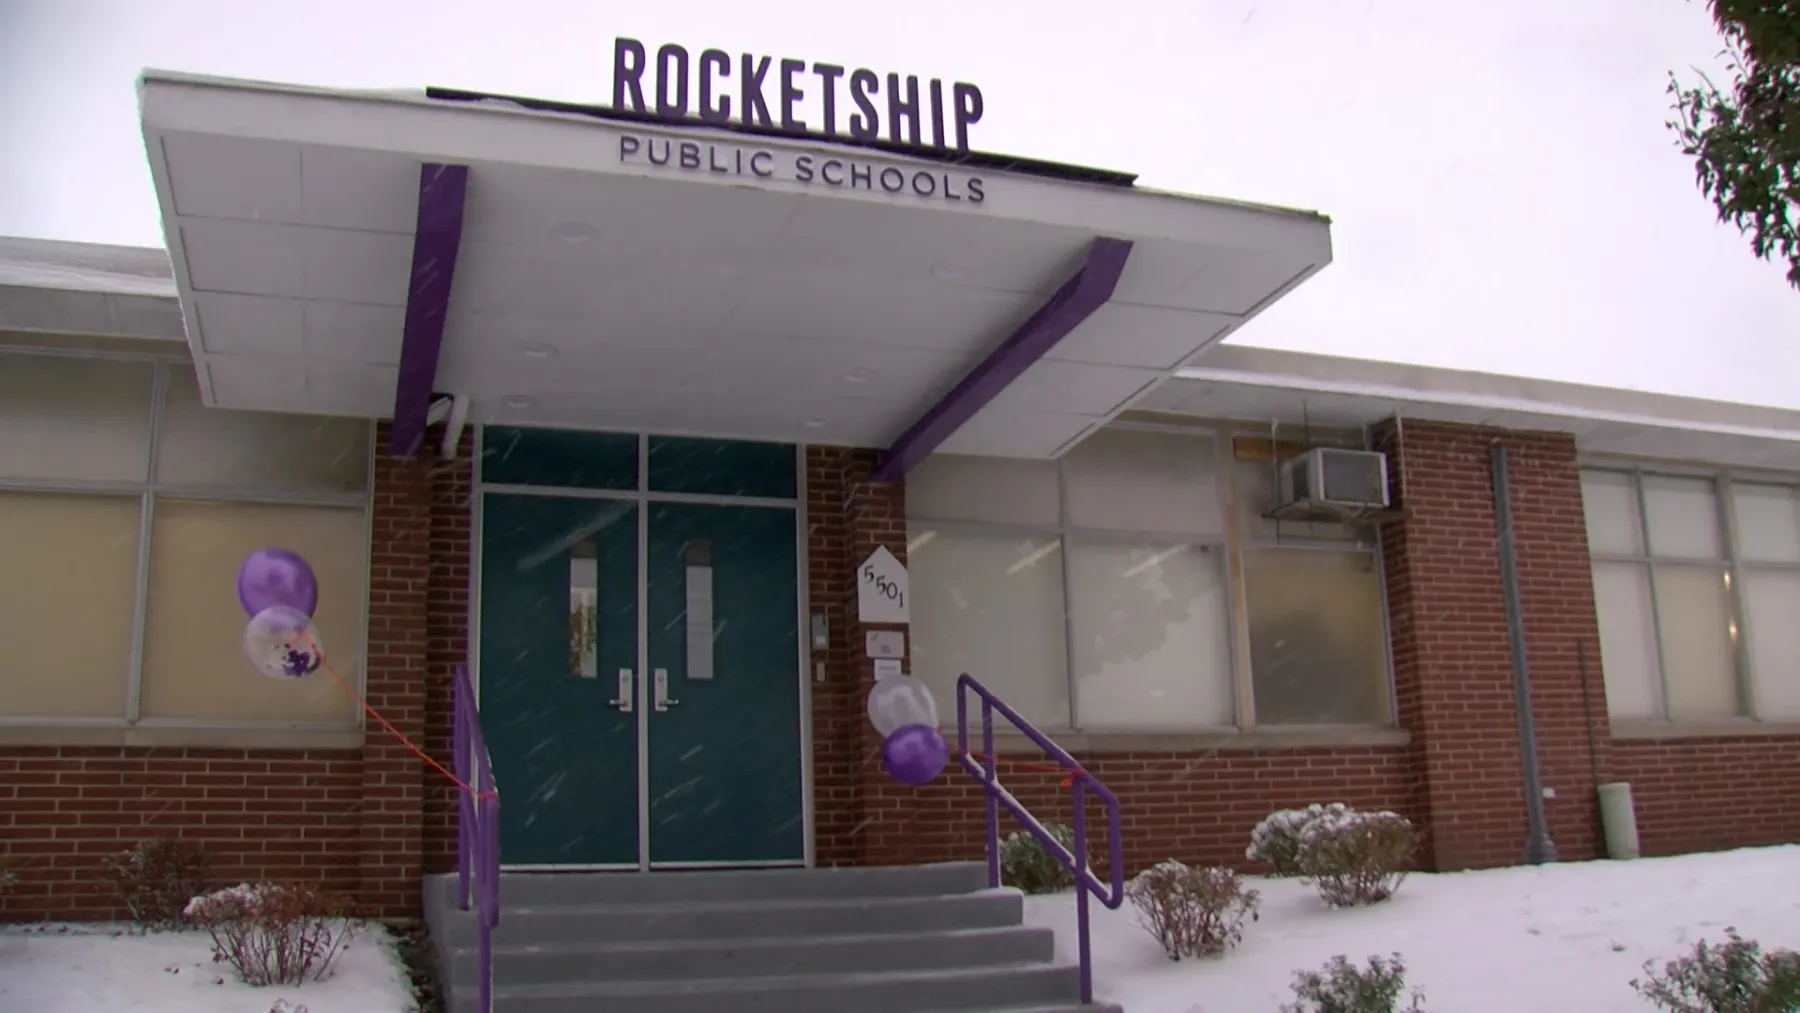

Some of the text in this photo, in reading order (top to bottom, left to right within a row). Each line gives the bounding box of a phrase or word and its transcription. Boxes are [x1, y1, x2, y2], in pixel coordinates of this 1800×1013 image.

[612, 36, 984, 152] ROCKETSHIP
[620, 135, 985, 203] PUBLIC SCHOOLS
[863, 564, 904, 608] 5501
